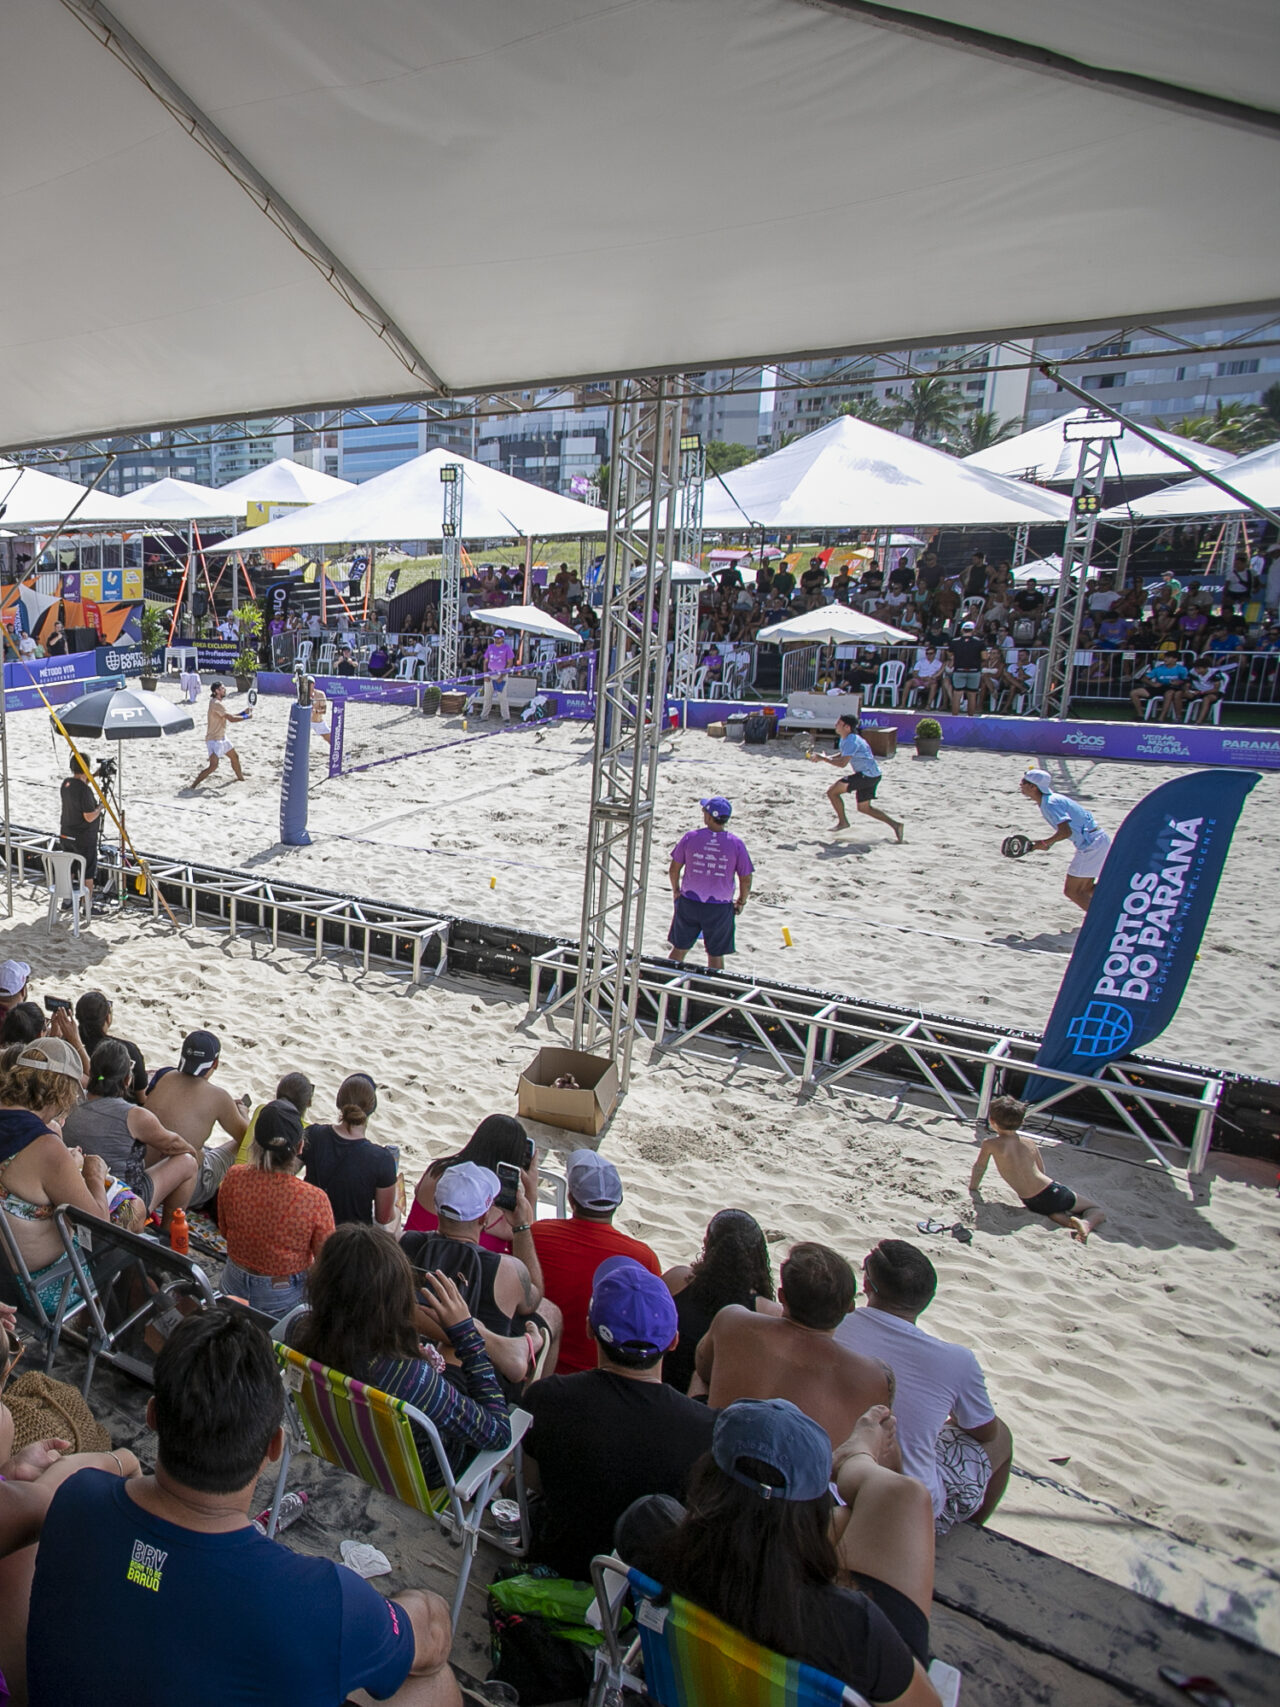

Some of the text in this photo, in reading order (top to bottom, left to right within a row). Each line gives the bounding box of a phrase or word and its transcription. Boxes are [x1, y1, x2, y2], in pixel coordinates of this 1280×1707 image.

[120, 652, 148, 662] PORTO
[63, 664, 75, 673] VITA
[121, 660, 132, 669] DO
[1062, 734, 1105, 746] JOGOS
[1183, 818, 1217, 917] INTELIGENTE
[1120, 816, 1203, 1001] DO PARANÁ
[1093, 872, 1159, 997] PORTOS
[131, 1539, 168, 1571] BRV
[146, 1567, 153, 1576] TO
